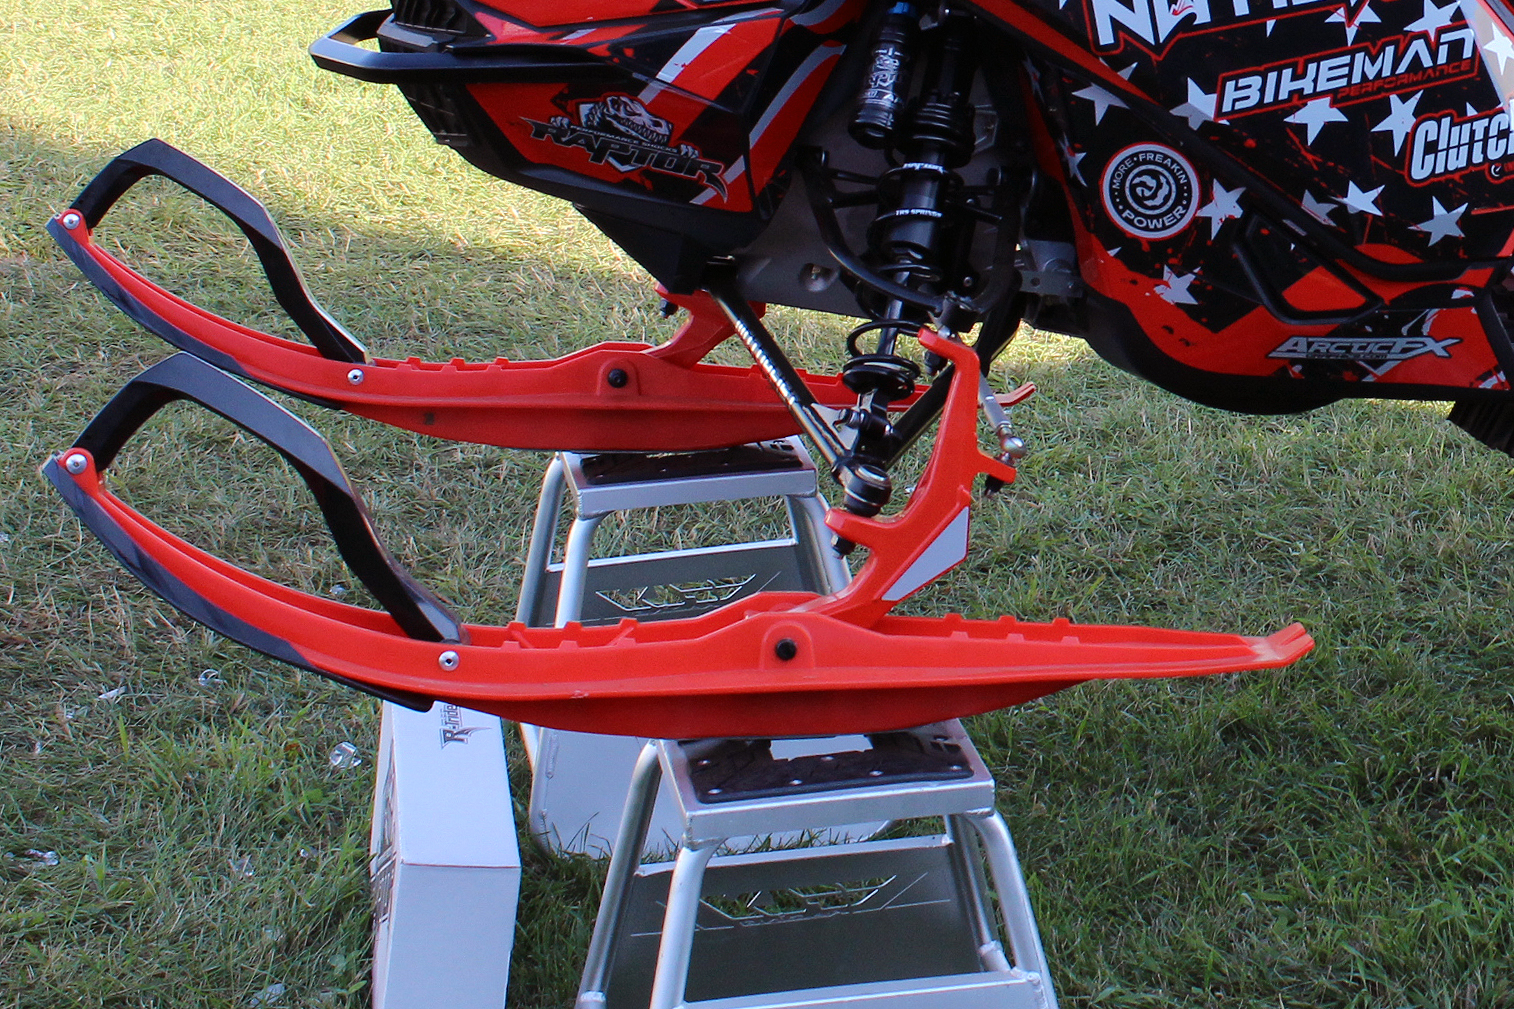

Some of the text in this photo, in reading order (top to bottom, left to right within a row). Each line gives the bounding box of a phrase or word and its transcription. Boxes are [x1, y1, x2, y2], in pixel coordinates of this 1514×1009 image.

[1222, 27, 1476, 113] BIKEMAN
[1337, 59, 1472, 99] PERFORMANCE
[570, 125, 678, 154] PERFORMANCE SHOCKS
[519, 116, 729, 203] RAPTOR
[1112, 152, 1188, 190] MORE FREAKIN
[1122, 205, 1187, 229] POWER
